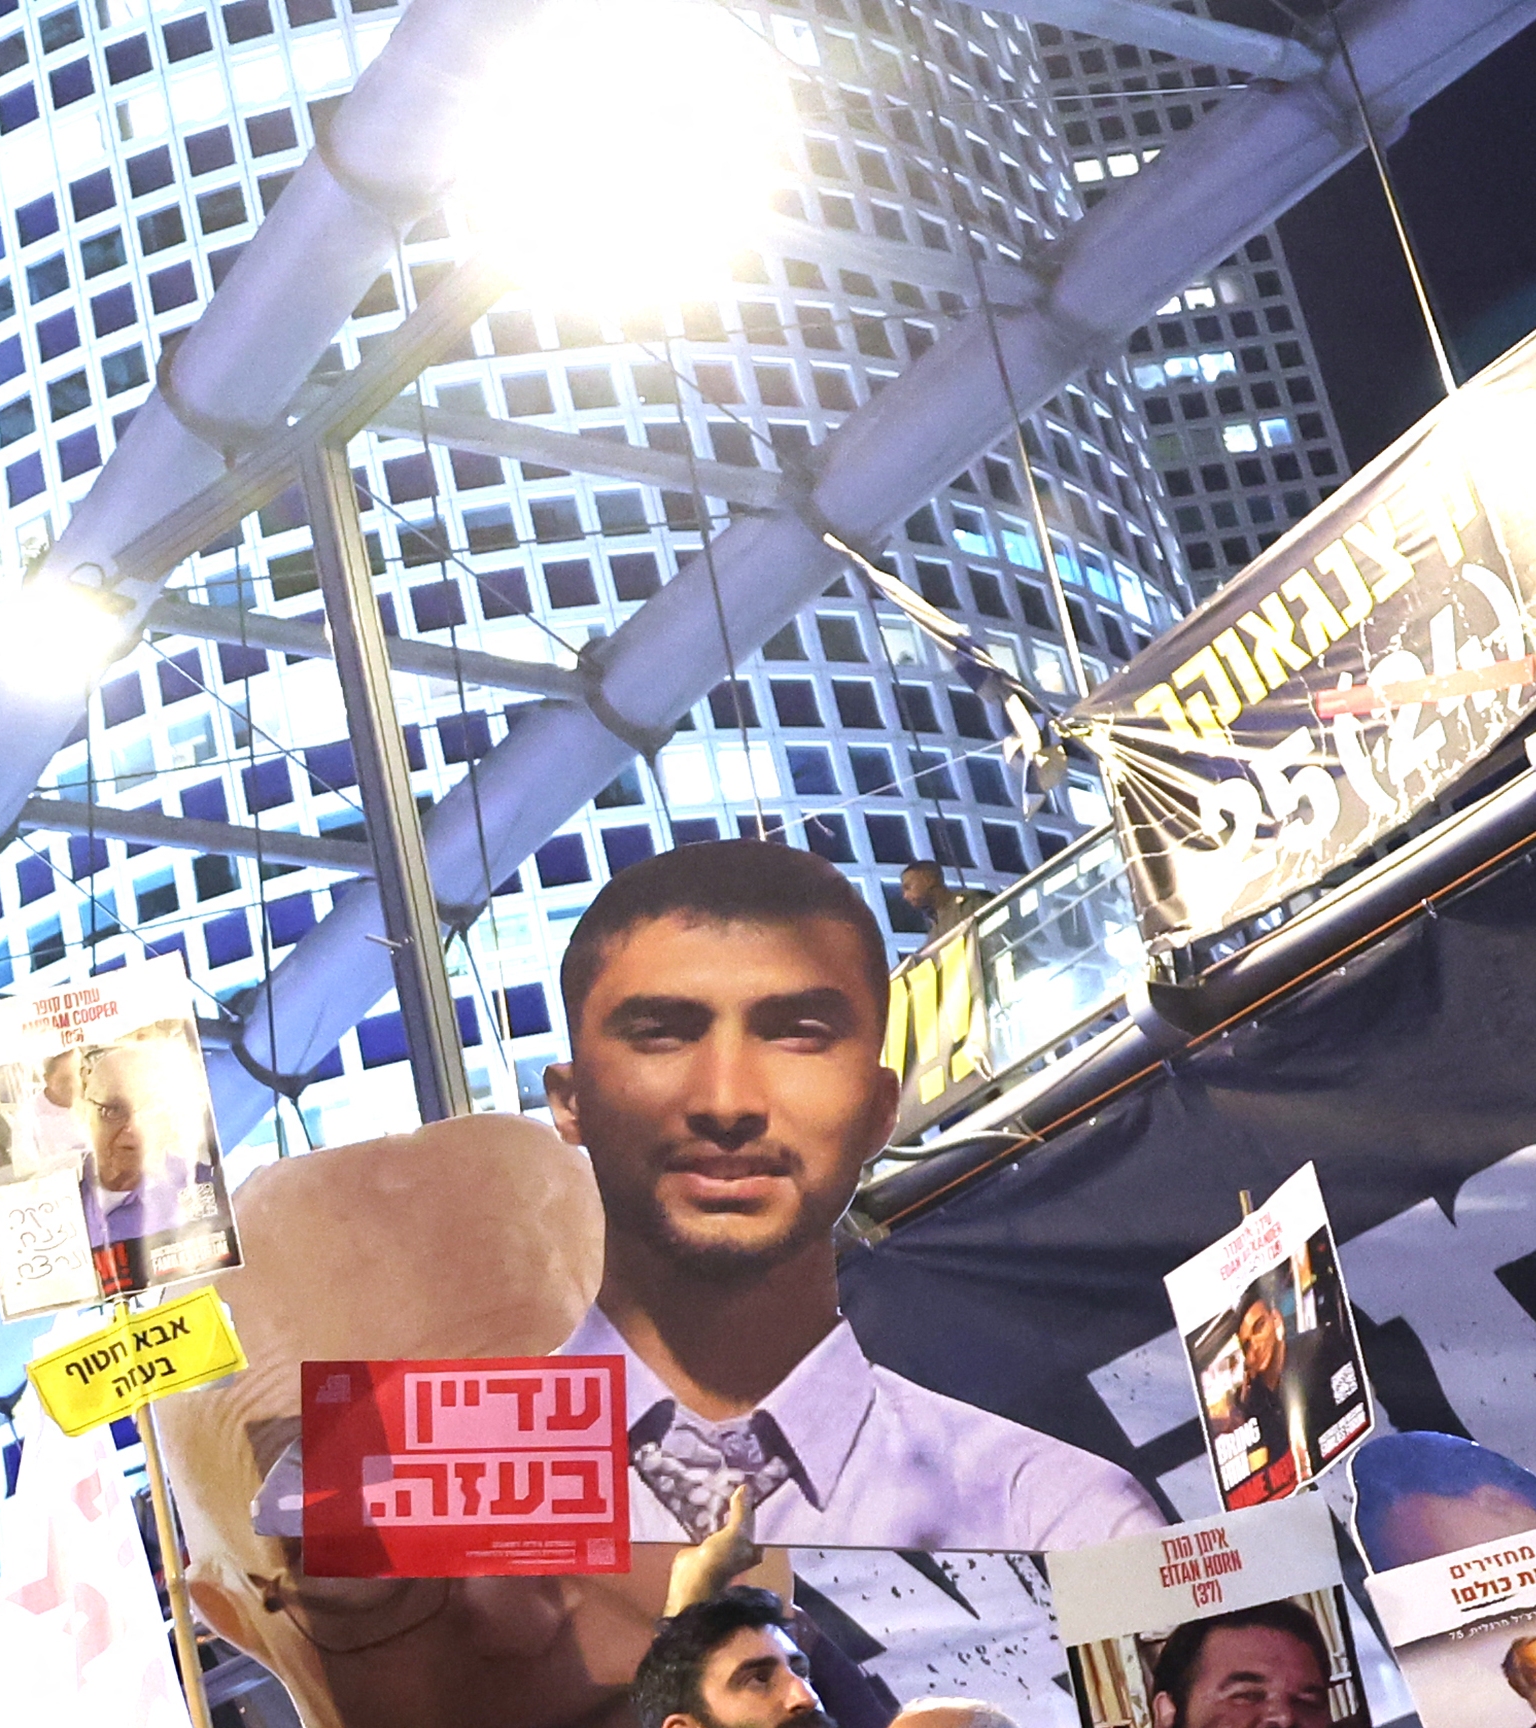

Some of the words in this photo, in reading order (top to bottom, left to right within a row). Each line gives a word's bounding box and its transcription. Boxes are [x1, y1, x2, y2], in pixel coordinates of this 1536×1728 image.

[73, 1001, 119, 1026] COOPER
[131, 1315, 191, 1352] אבא
[65, 1341, 128, 1385] חטוף
[111, 1356, 177, 1398] בעזה
[416, 1377, 602, 1443] עדיין
[1214, 1417, 1261, 1466] BRING
[370, 1460, 607, 1517] בעזה.
[1161, 1535, 1194, 1564] הורן
[1194, 1526, 1229, 1556] איתן
[1159, 1558, 1201, 1588] EITAN
[1202, 1548, 1243, 1578] HORN
[1449, 1545, 1536, 1580] מחזירים
[1191, 1578, 1223, 1608] (37)
[1450, 1576, 1512, 1605] כולם!
